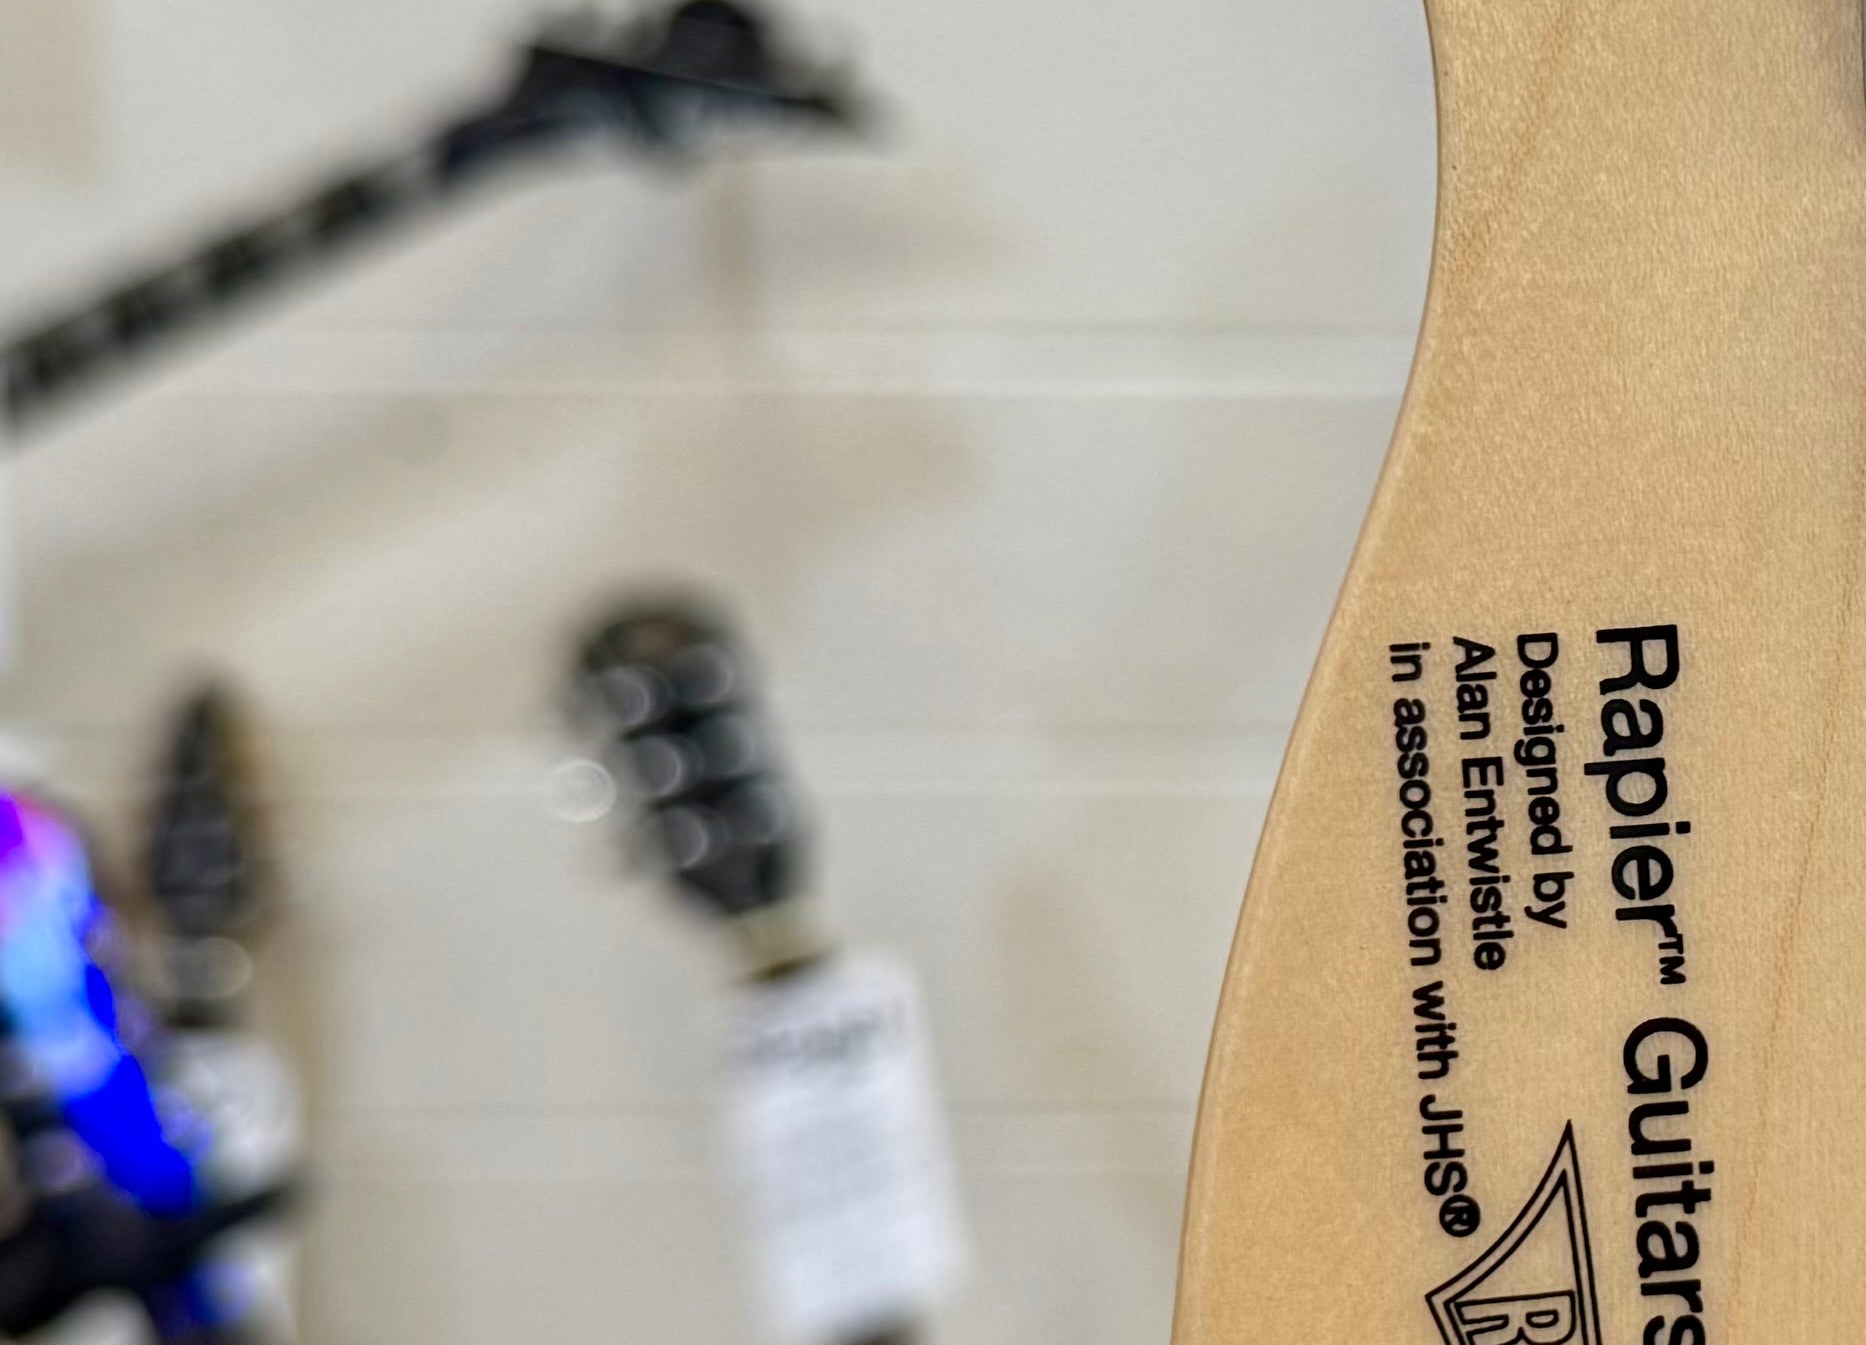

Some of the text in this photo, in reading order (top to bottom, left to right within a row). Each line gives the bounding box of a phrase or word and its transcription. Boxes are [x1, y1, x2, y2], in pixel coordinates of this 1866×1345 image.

[1388, 641, 1431, 683] in
[1513, 631, 1575, 930] Designed by
[1392, 697, 1449, 967] association
[1452, 636, 1515, 971] Alan Entwistle
[1411, 980, 1459, 1081] with
